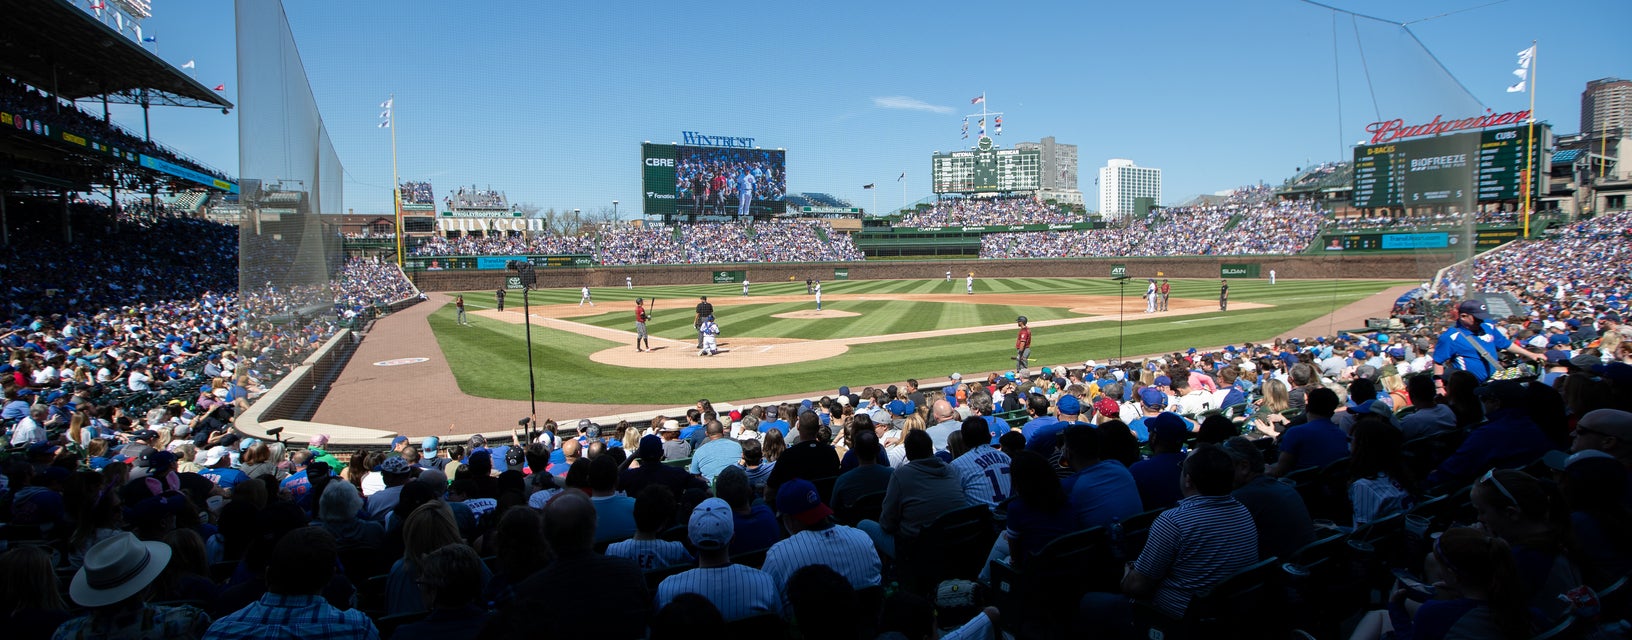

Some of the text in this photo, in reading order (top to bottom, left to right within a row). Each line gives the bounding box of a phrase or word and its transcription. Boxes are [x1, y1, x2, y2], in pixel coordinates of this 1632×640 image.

[1365, 108, 1531, 144] Budweiser
[1495, 131, 1517, 140] CUBS
[1367, 146, 1395, 155] D-BACKS
[645, 157, 674, 167] CBRE
[1411, 154, 1466, 167] BIOFREEZE
[437, 218, 544, 231] nuveen
[974, 451, 1012, 469] BRYAN
